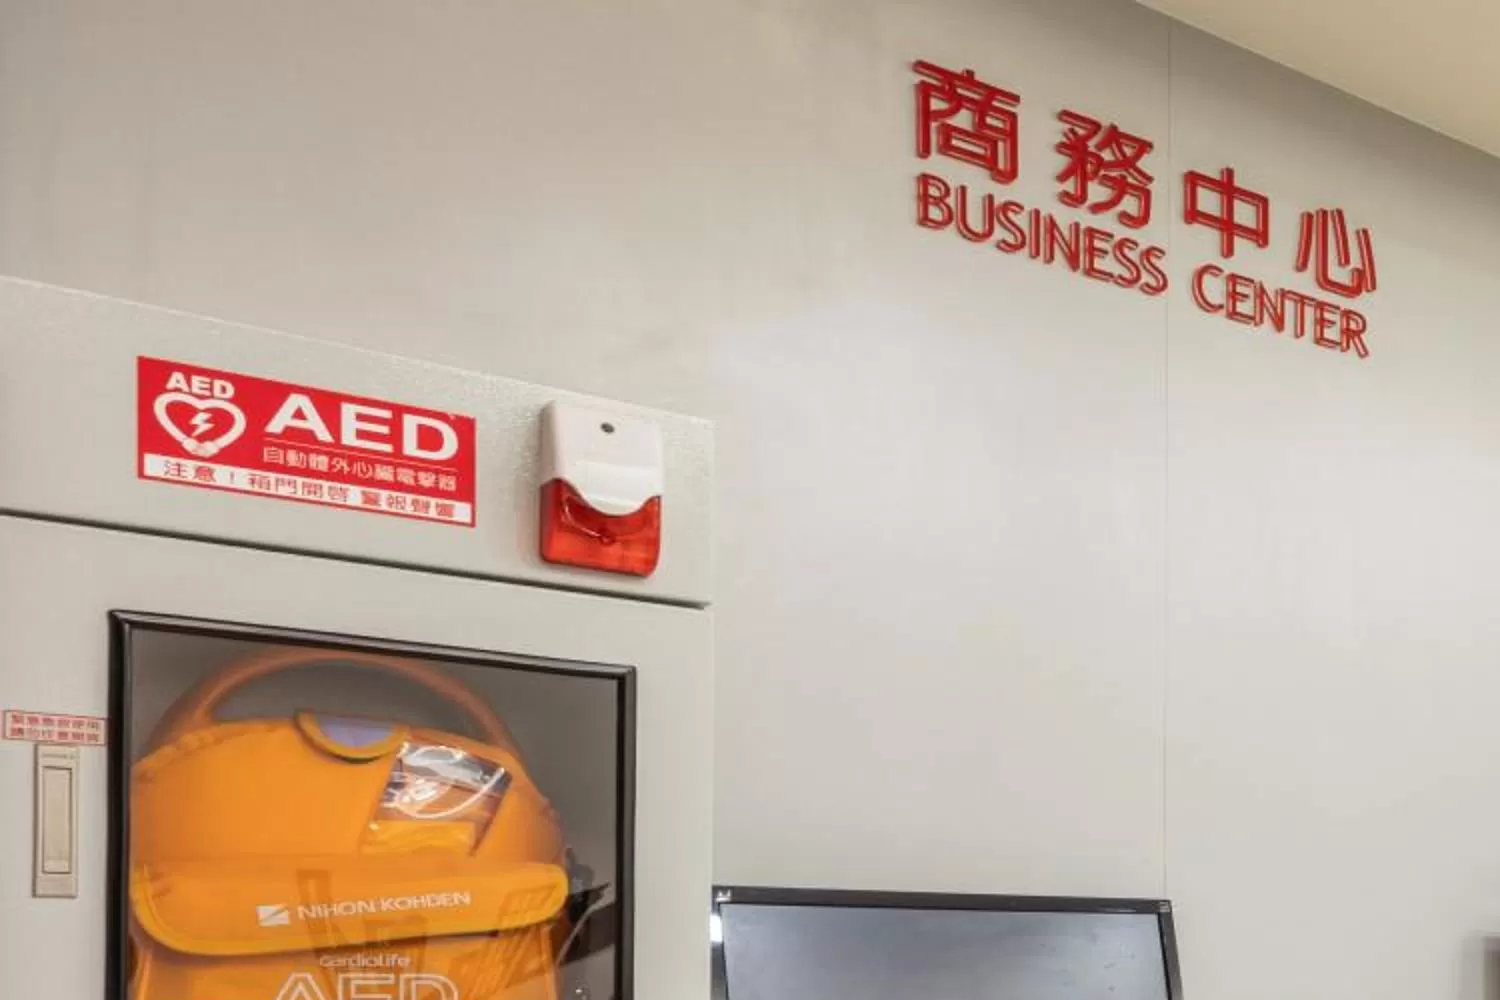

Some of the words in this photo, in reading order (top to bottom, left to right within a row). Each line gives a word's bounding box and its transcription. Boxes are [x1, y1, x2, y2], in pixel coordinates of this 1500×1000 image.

[912, 59, 1377, 299] 商務中心
[915, 172, 1169, 296] BUSINESS
[1191, 263, 1369, 358] CENTER
[165, 371, 236, 400] AED
[264, 392, 460, 461] AED
[298, 900, 377, 920] NIHON
[380, 891, 472, 913] KOHDEN
